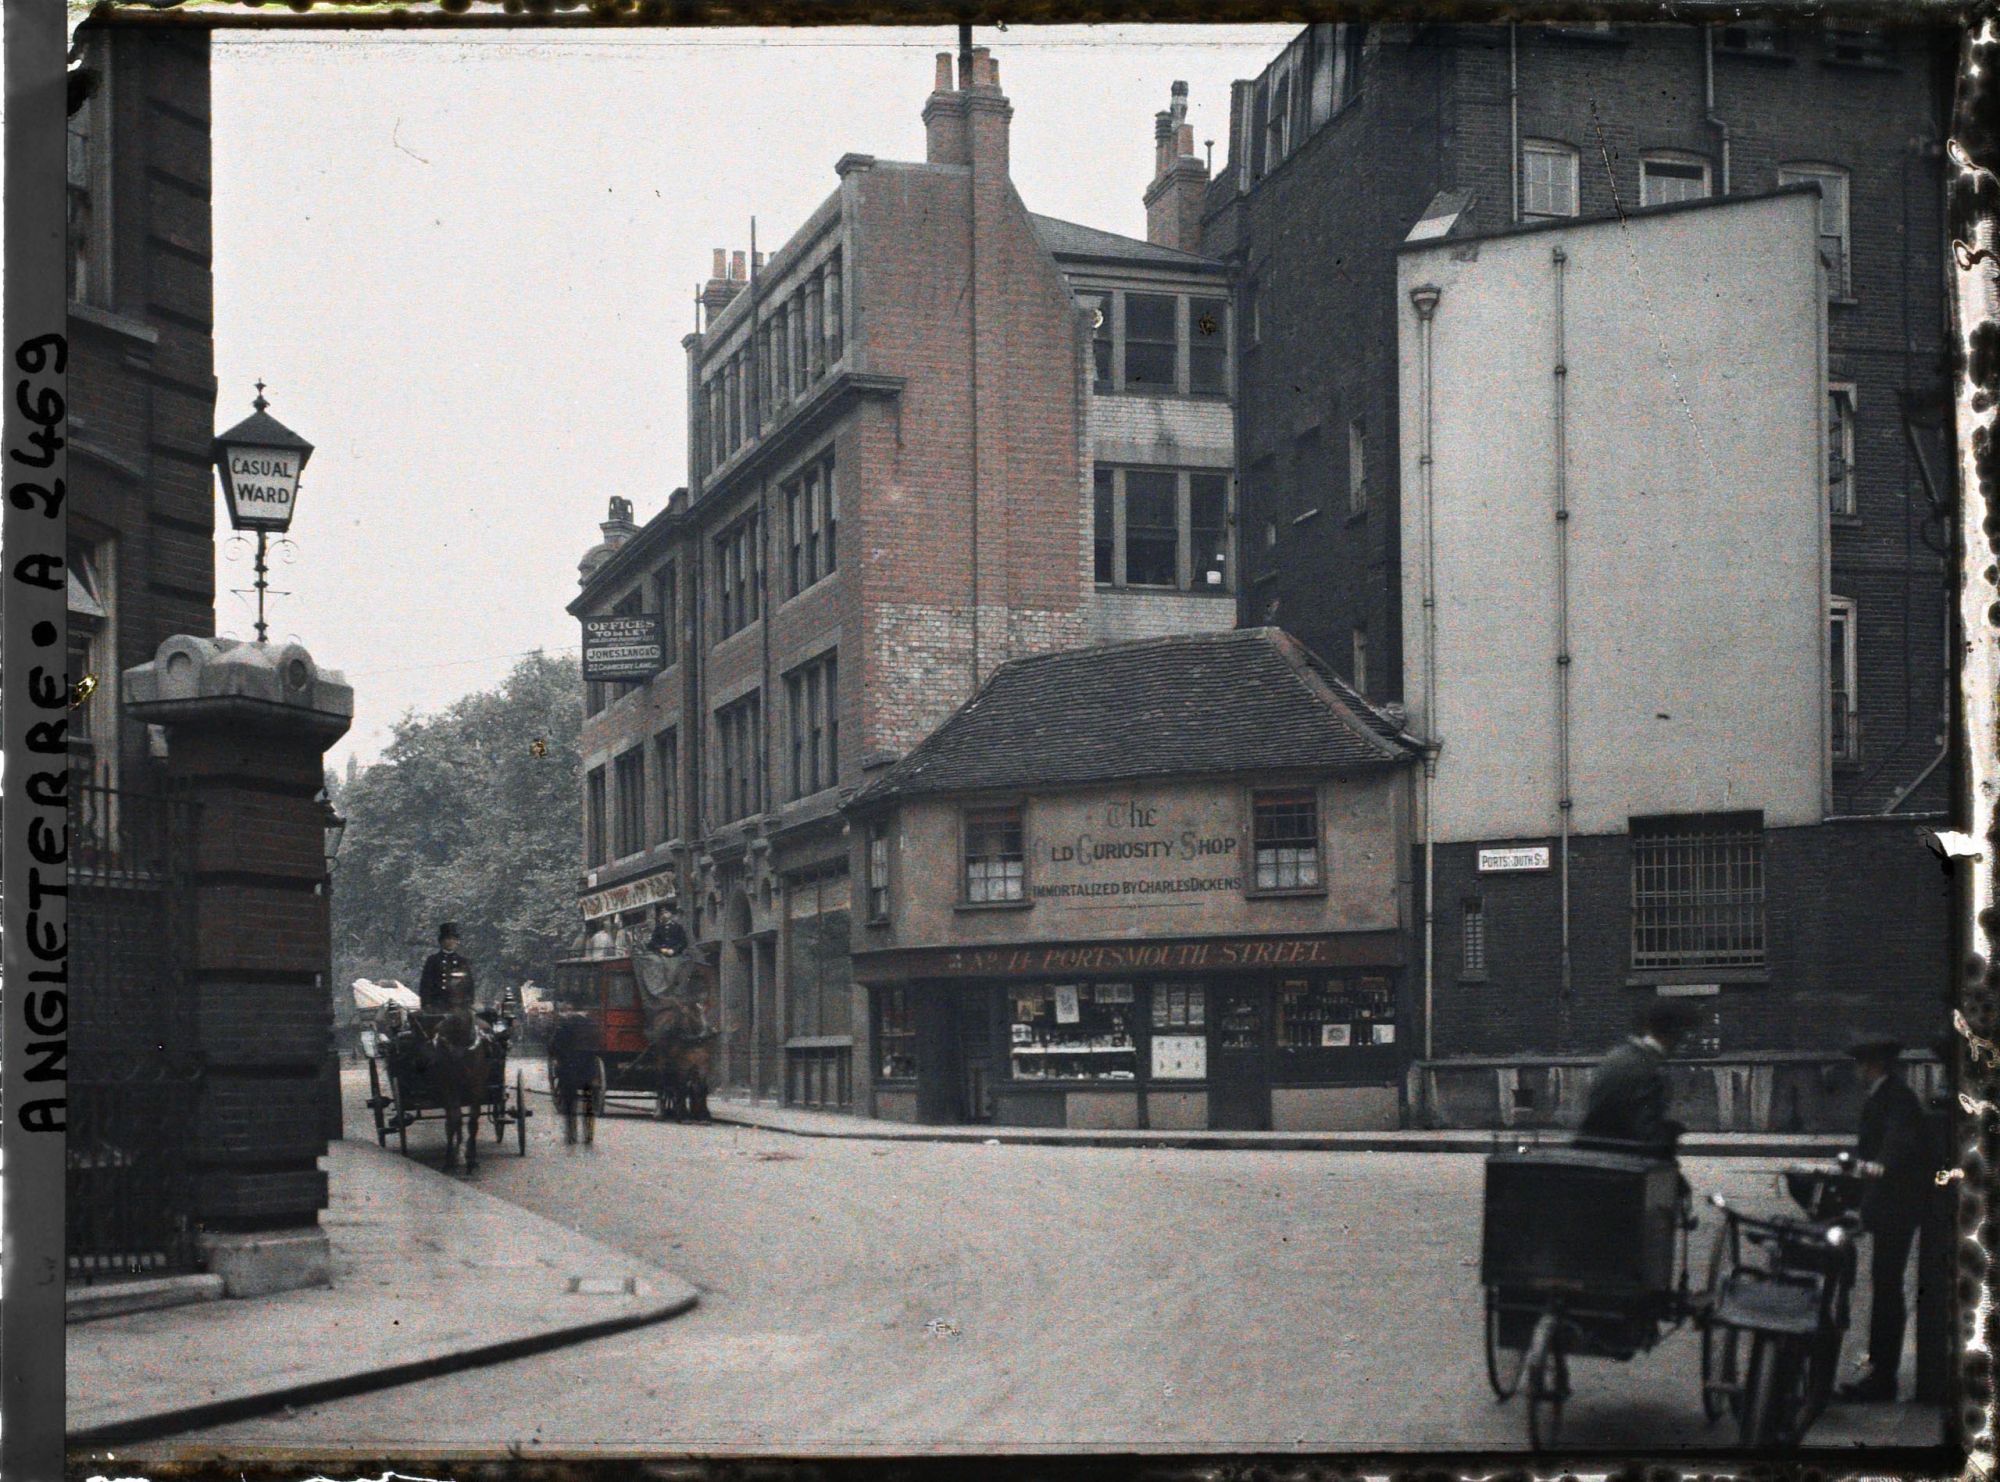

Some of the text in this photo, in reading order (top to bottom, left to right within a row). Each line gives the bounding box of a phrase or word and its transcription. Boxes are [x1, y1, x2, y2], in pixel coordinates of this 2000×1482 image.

[231, 457, 293, 479] CASUAL
[236, 484, 290, 504] WARD
[587, 620, 655, 631] OFFICES
[625, 628, 648, 636] LET
[1107, 800, 1158, 828] The
[1077, 833, 1174, 865] CURIOSITY
[1180, 831, 1237, 861] SHOP
[1033, 877, 1242, 897] IMMORTALIZED BY CHARLES DICKENS
[1042, 945, 1209, 970] PORTSMOUTH
